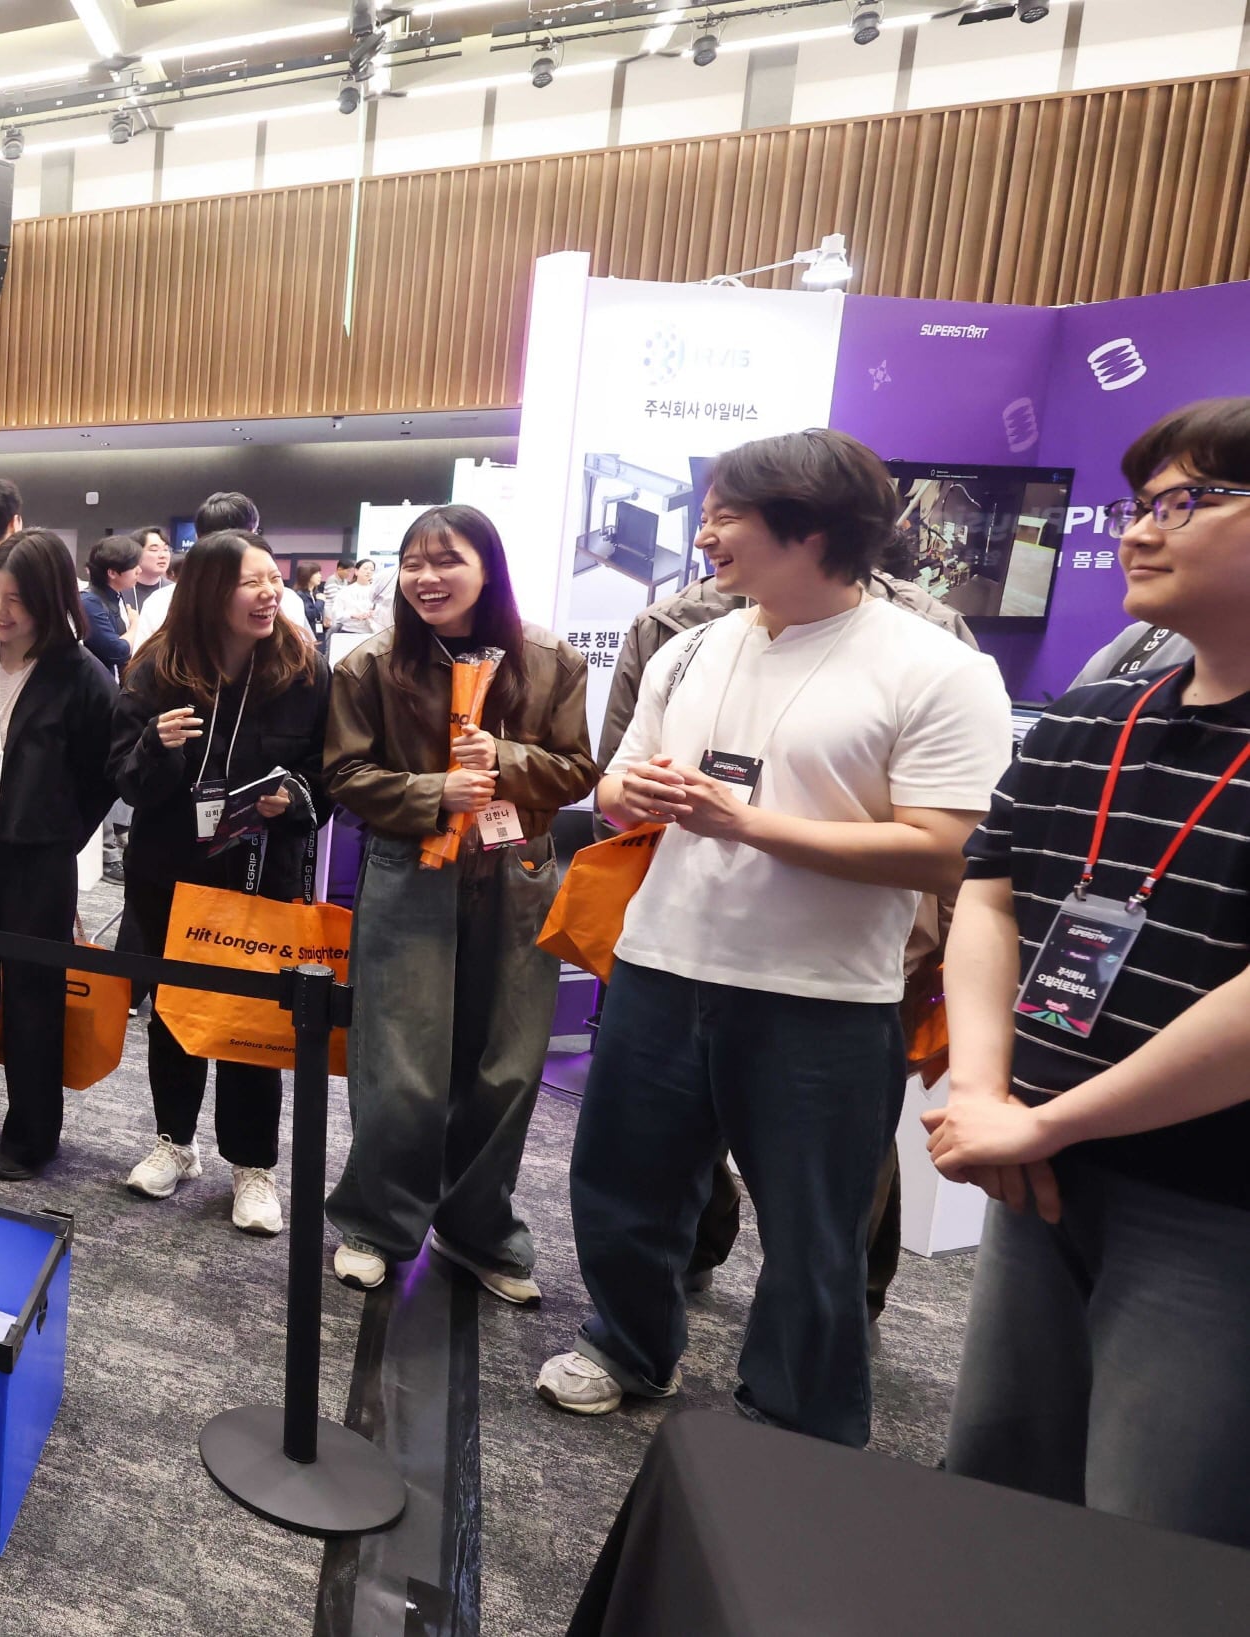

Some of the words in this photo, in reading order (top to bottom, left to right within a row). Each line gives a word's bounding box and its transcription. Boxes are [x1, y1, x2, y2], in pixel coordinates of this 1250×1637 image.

[919, 323, 989, 339] SUPERSTART
[644, 399, 700, 420] 주식회사
[704, 402, 759, 422] 아일비스
[1072, 550, 1115, 569] 몸을
[567, 631, 592, 648] 로봇
[594, 631, 620, 648] 정밀
[483, 809, 510, 822] 김한나
[245, 852, 257, 890] G-GRIP
[185, 926, 212, 943] Hit
[213, 932, 277, 955] Longer
[279, 945, 293, 959] &
[1057, 966, 1086, 982] 주식회사
[1035, 973, 1098, 1000] 오일러로보틱스
[229, 1038, 263, 1050] Serious
